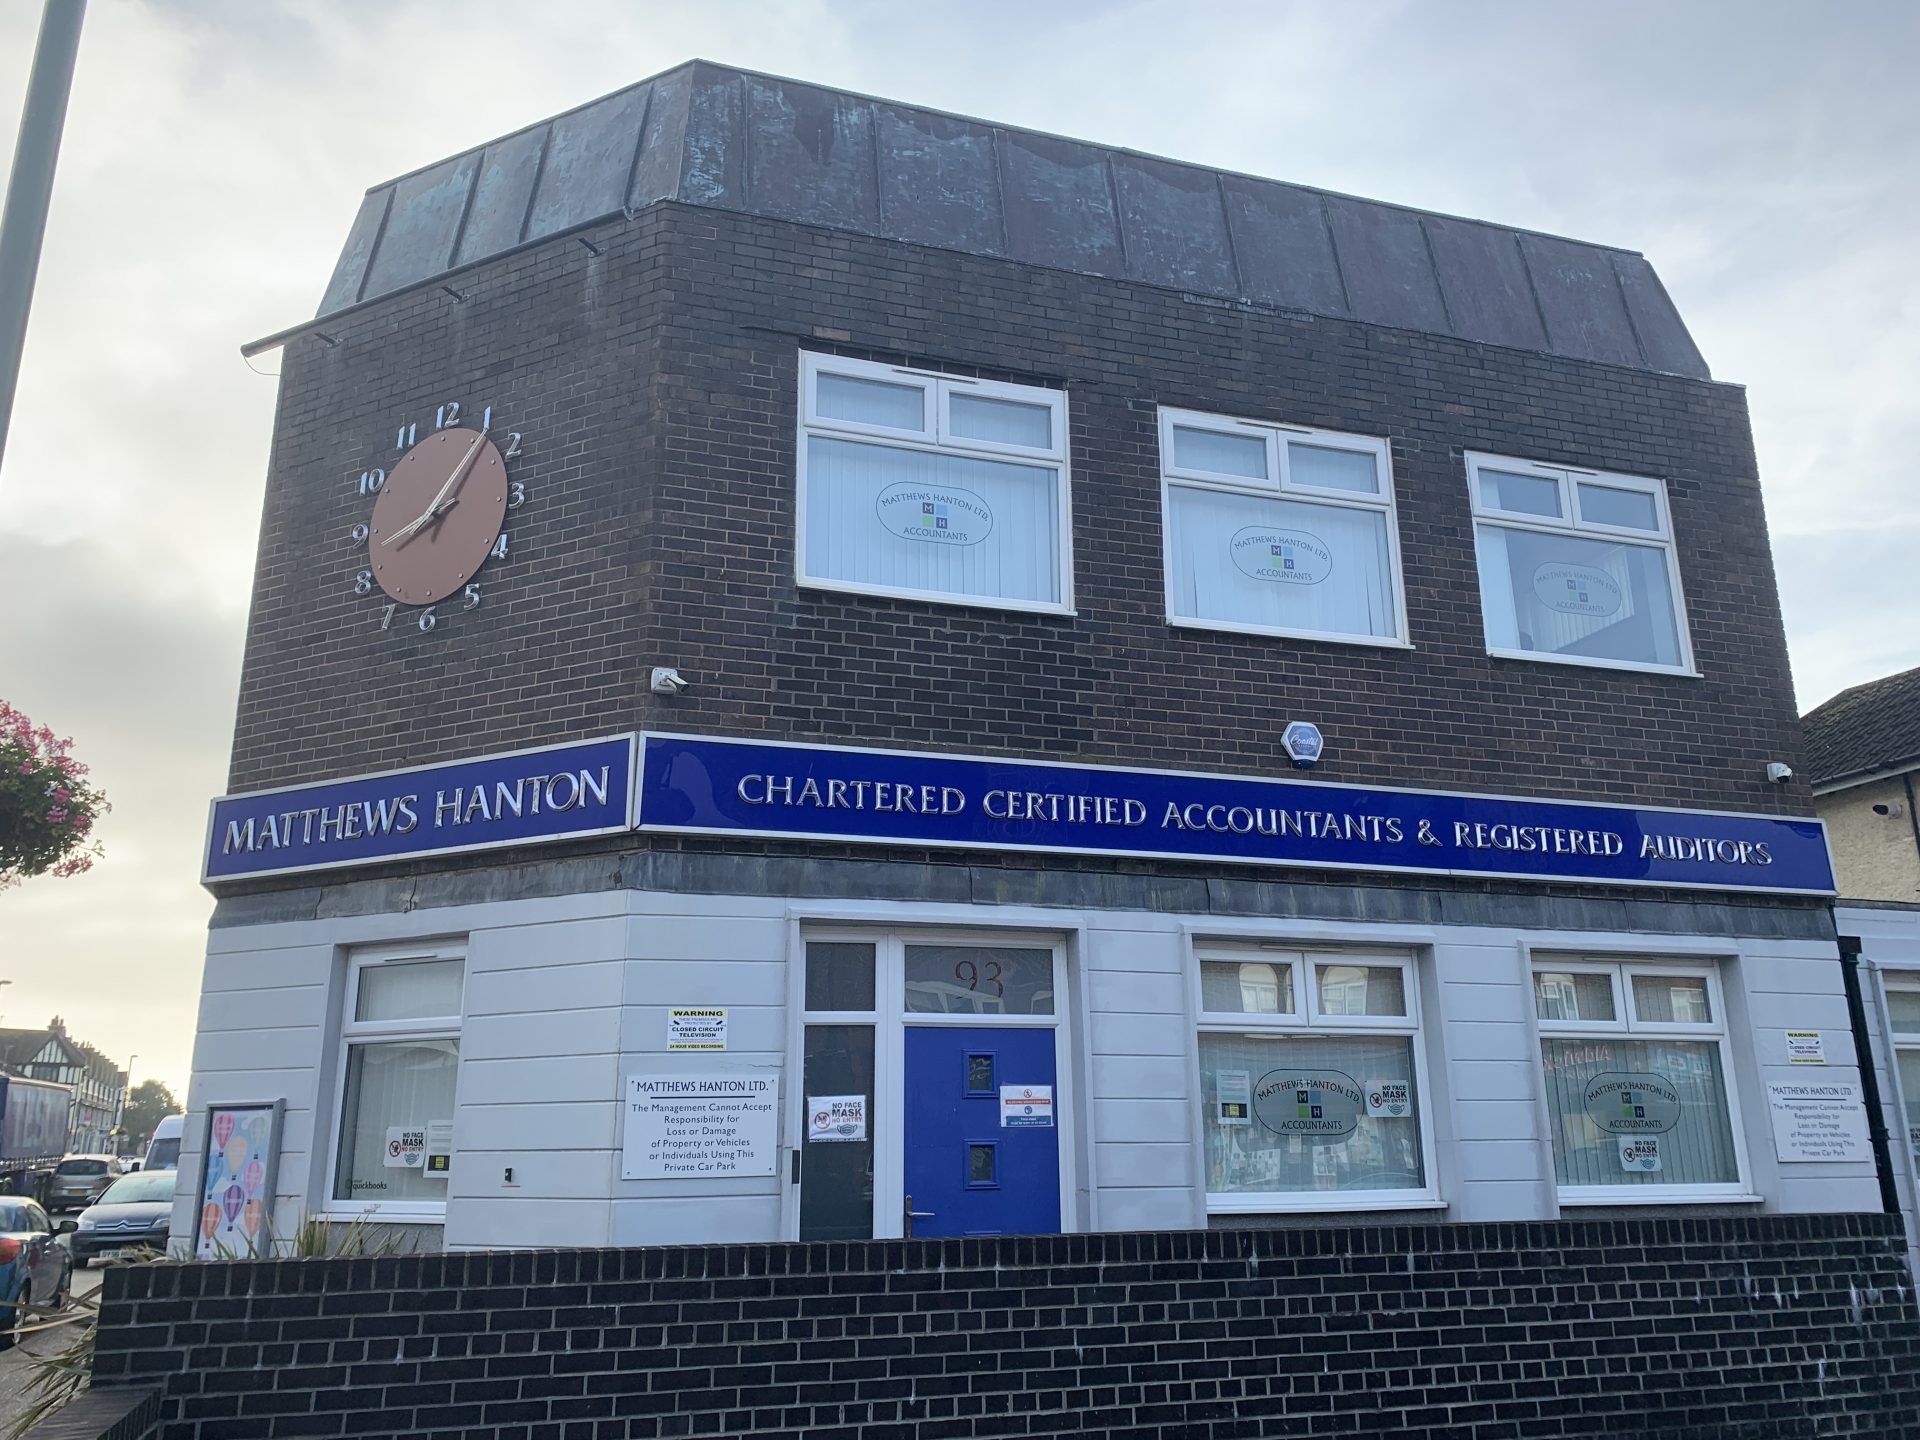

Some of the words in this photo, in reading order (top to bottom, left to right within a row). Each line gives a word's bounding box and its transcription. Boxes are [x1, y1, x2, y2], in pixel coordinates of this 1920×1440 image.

[436, 402, 460, 429] 12
[483, 406, 491, 430] 1
[396, 422, 417, 449] 11
[505, 432, 522, 462] 2
[359, 468, 385, 496] 10
[508, 482, 525, 509] 3
[881, 492, 931, 507] MATTHEWS
[933, 493, 973, 511] HANTON
[352, 523, 369, 549] 9
[903, 527, 968, 541] ACCOUNTANTS
[491, 534, 509, 559] 4
[1234, 536, 1277, 550] MATTHEWS
[1279, 537, 1314, 552] HANTON
[354, 570, 371, 595] 8
[1256, 568, 1313, 581] ACCOUNTANTS
[464, 583, 481, 611] 5
[381, 603, 396, 630] 7
[419, 606, 436, 632] 6
[221, 795, 418, 856] MATTHEWS
[433, 765, 611, 829] HANTON
[737, 774, 966, 816] CHARTERED
[982, 789, 1147, 827] CERTIFIED
[1160, 801, 1404, 844] ACCOUNTANTS
[1417, 818, 1443, 847] &
[1453, 821, 1623, 857] REGISTERED
[1639, 833, 1773, 866] AUDITORS
[636, 1081, 696, 1092] MATTHEWS
[699, 1081, 746, 1091] HANTON
[748, 1081, 769, 1091] LTD.
[1258, 1080, 1304, 1101] MATTHEWS
[1307, 1080, 1344, 1095] HANTON
[1346, 1089, 1360, 1104] LTD.
[1382, 1091, 1407, 1099] MASK
[1587, 1082, 1627, 1101] MATTHEWS
[1629, 1082, 1662, 1095] HANTON
[1772, 1087, 1809, 1095] MATTHEWS
[1810, 1087, 1839, 1095] HANTON
[632, 1104, 649, 1112] The
[651, 1104, 706, 1114] Management
[709, 1103, 741, 1112] Cannot
[742, 1103, 772, 1112] Accept
[832, 1108, 862, 1117] MASK
[664, 1115, 725, 1126] Responsibility
[727, 1114, 740, 1123] for
[1281, 1121, 1343, 1130] ACCOUNTANTS
[1609, 1120, 1663, 1128] ACCOUNTANTS
[666, 1127, 686, 1136] Loss
[702, 1127, 737, 1137] Damage
[402, 1138, 424, 1146] MASK
[651, 1140, 661, 1148] of
[663, 1139, 702, 1149] Property
[715, 1138, 751, 1147] Vehicles
[662, 1151, 708, 1160] Individuals
[710, 1150, 735, 1160] Using
[737, 1149, 755, 1158] This
[664, 1163, 695, 1172] Private
[697, 1162, 714, 1171] Car
[716, 1162, 736, 1171] Park
[352, 1181, 387, 1191] quickbooks
